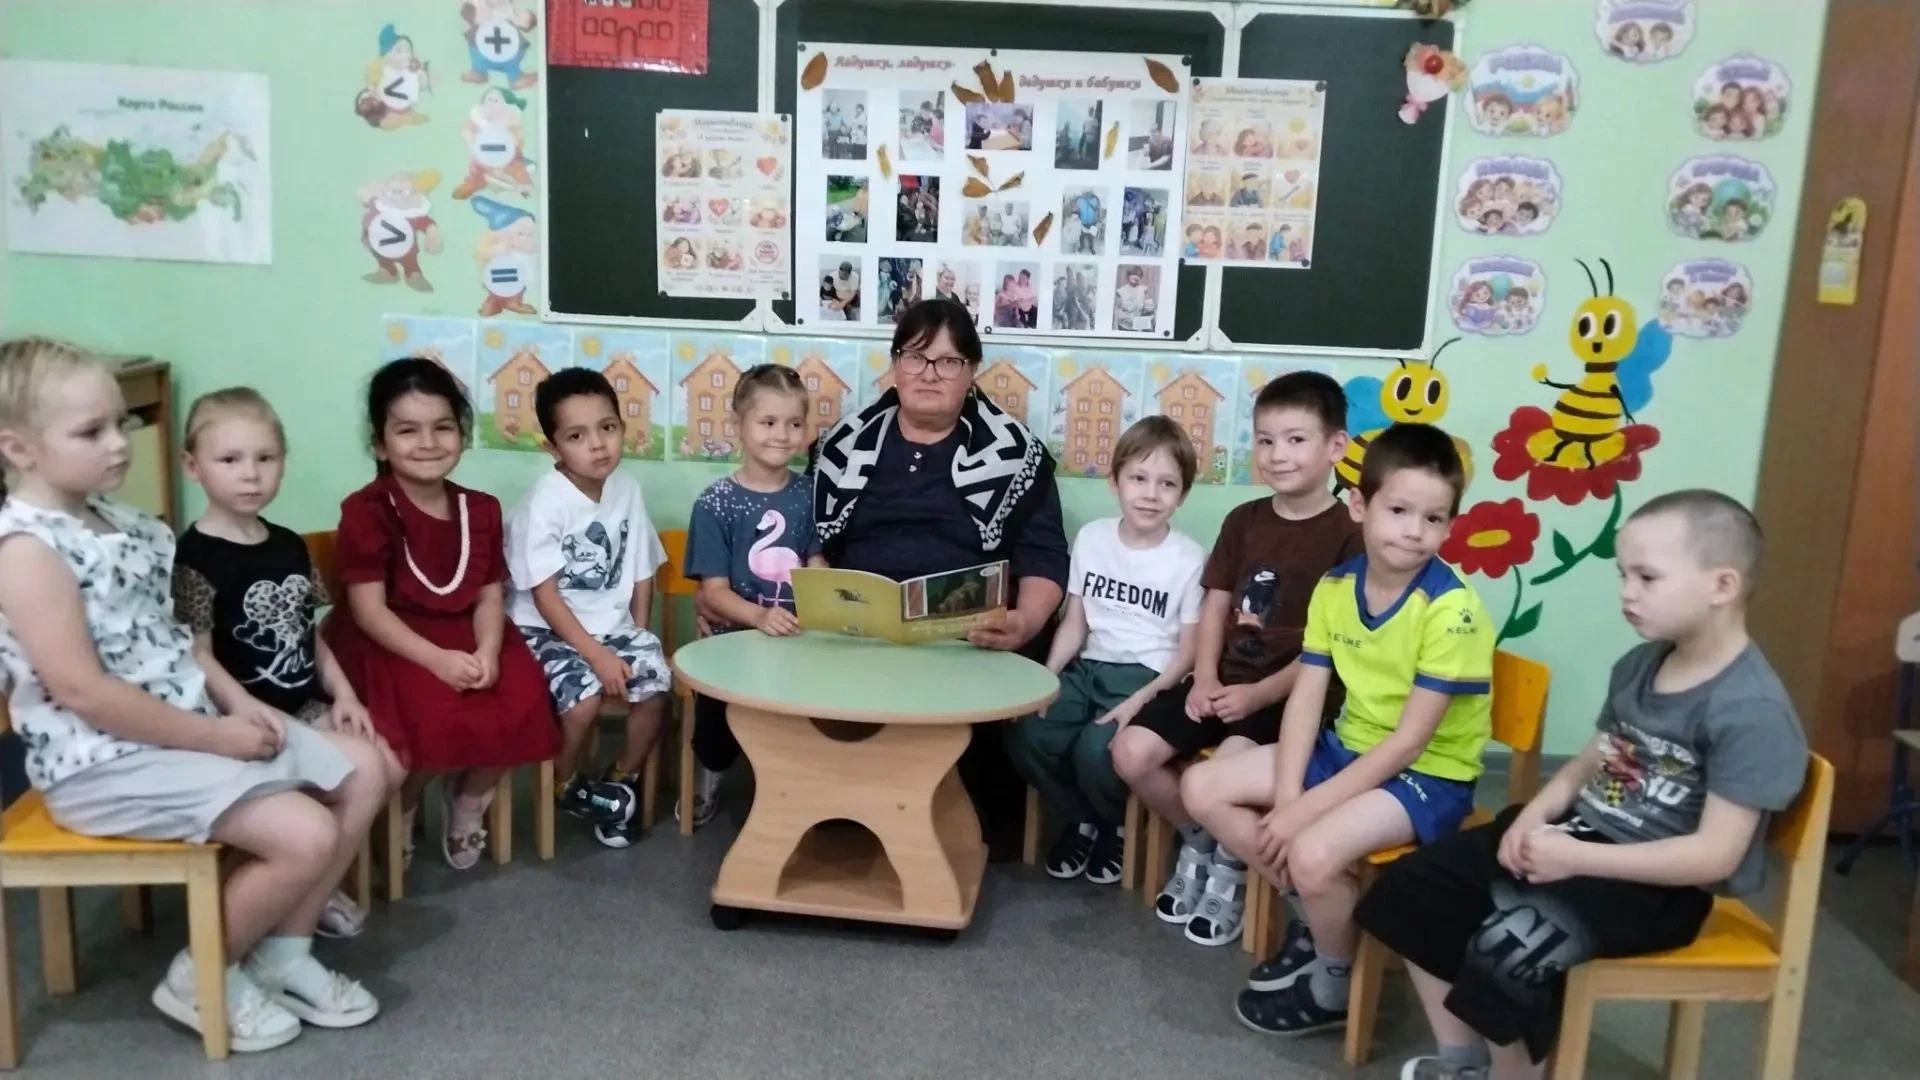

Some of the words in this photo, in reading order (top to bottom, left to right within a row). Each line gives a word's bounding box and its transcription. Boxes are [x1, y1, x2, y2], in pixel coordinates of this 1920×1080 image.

[1086, 75, 1142, 92] бабушки
[117, 97, 155, 111] Карта
[158, 98, 204, 113] России
[1082, 571, 1169, 619] FREEDOM
